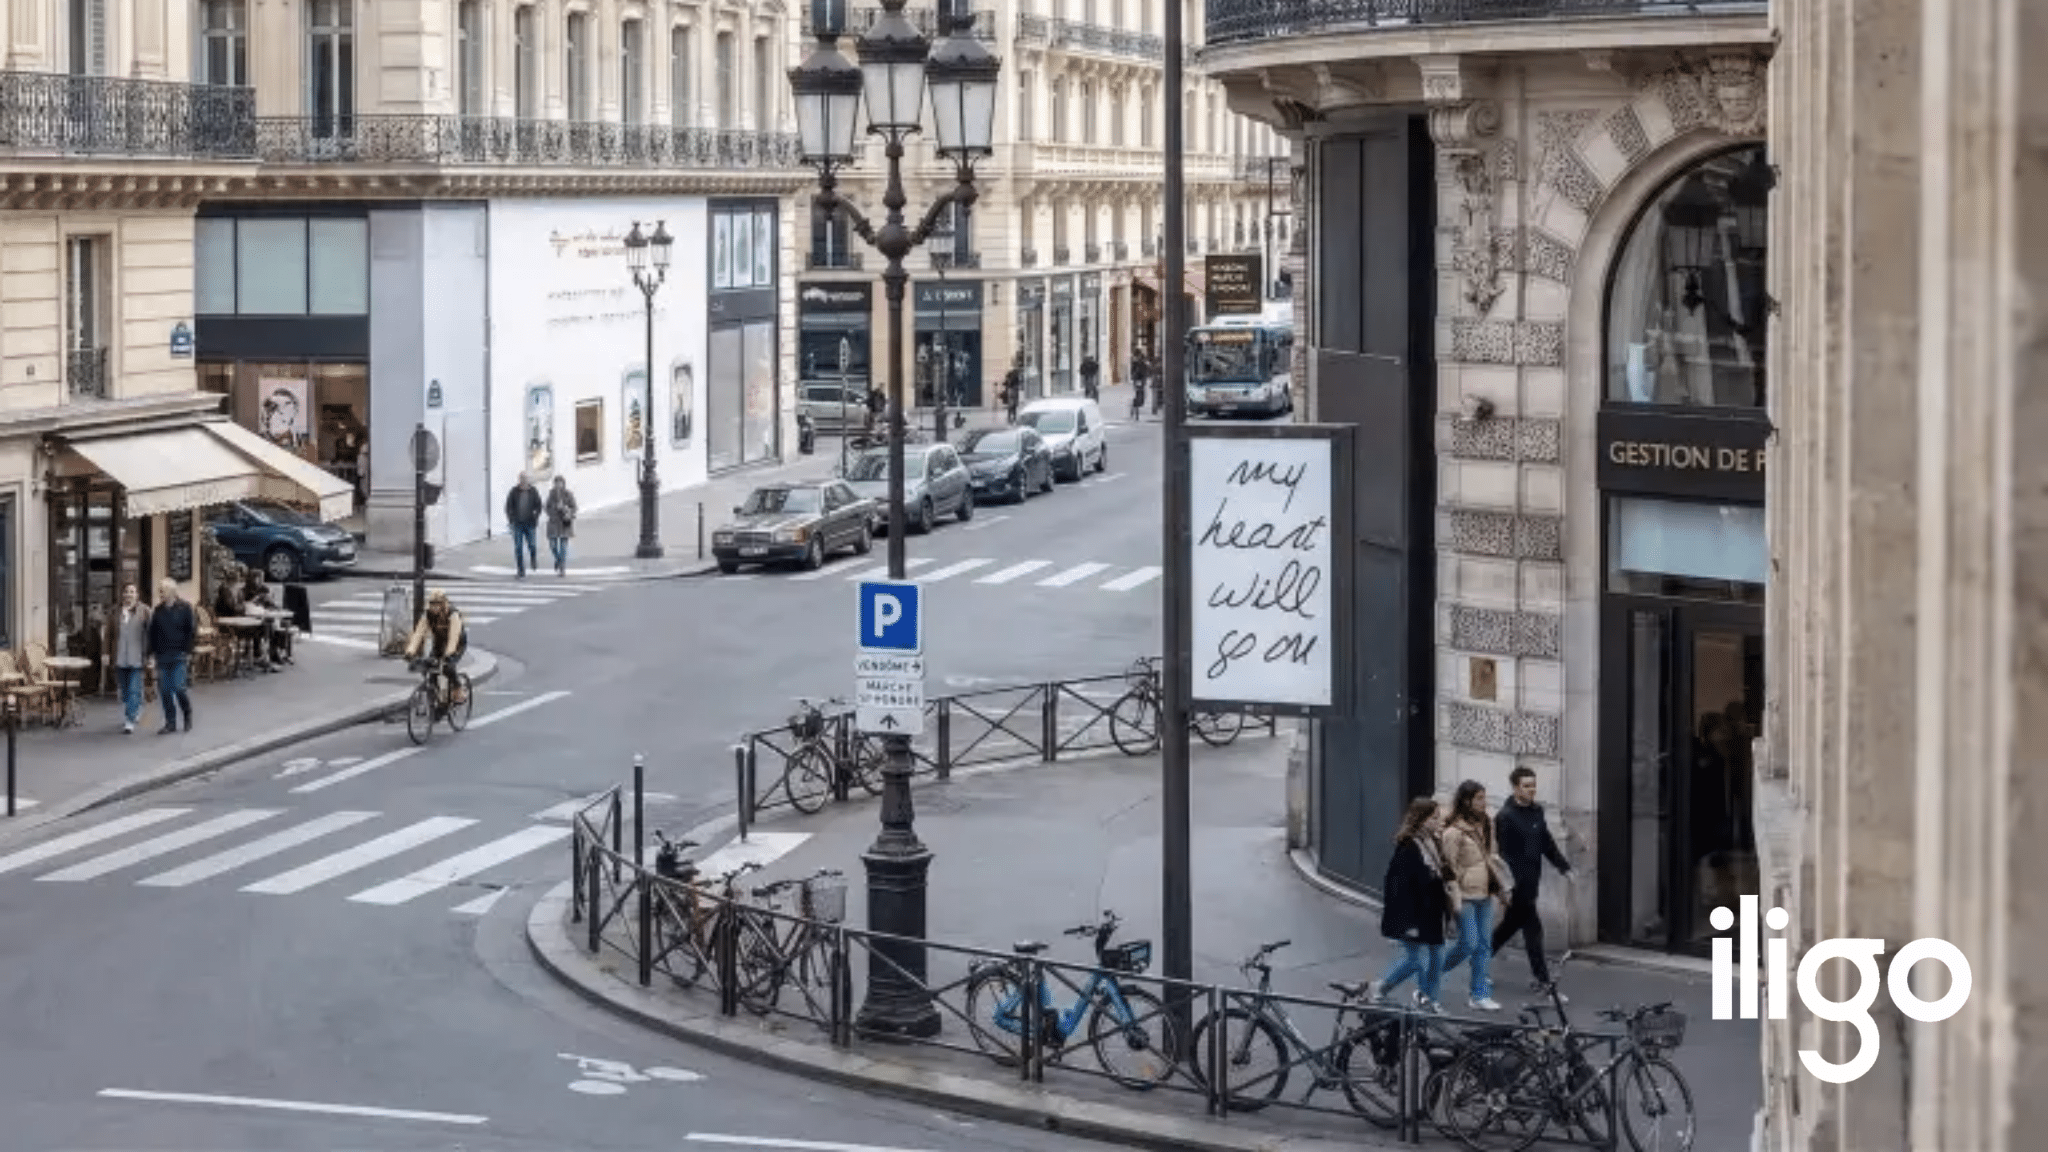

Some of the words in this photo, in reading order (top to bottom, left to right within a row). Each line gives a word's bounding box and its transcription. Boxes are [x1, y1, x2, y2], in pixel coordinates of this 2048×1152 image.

[1609, 441, 1711, 469] GESTION
[1717, 447, 1749, 472] DE
[1226, 460, 1308, 514] my
[1197, 497, 1326, 551] heart
[873, 592, 903, 638] P
[1207, 559, 1321, 619] will
[1206, 629, 1257, 680] go
[1263, 632, 1318, 666] on
